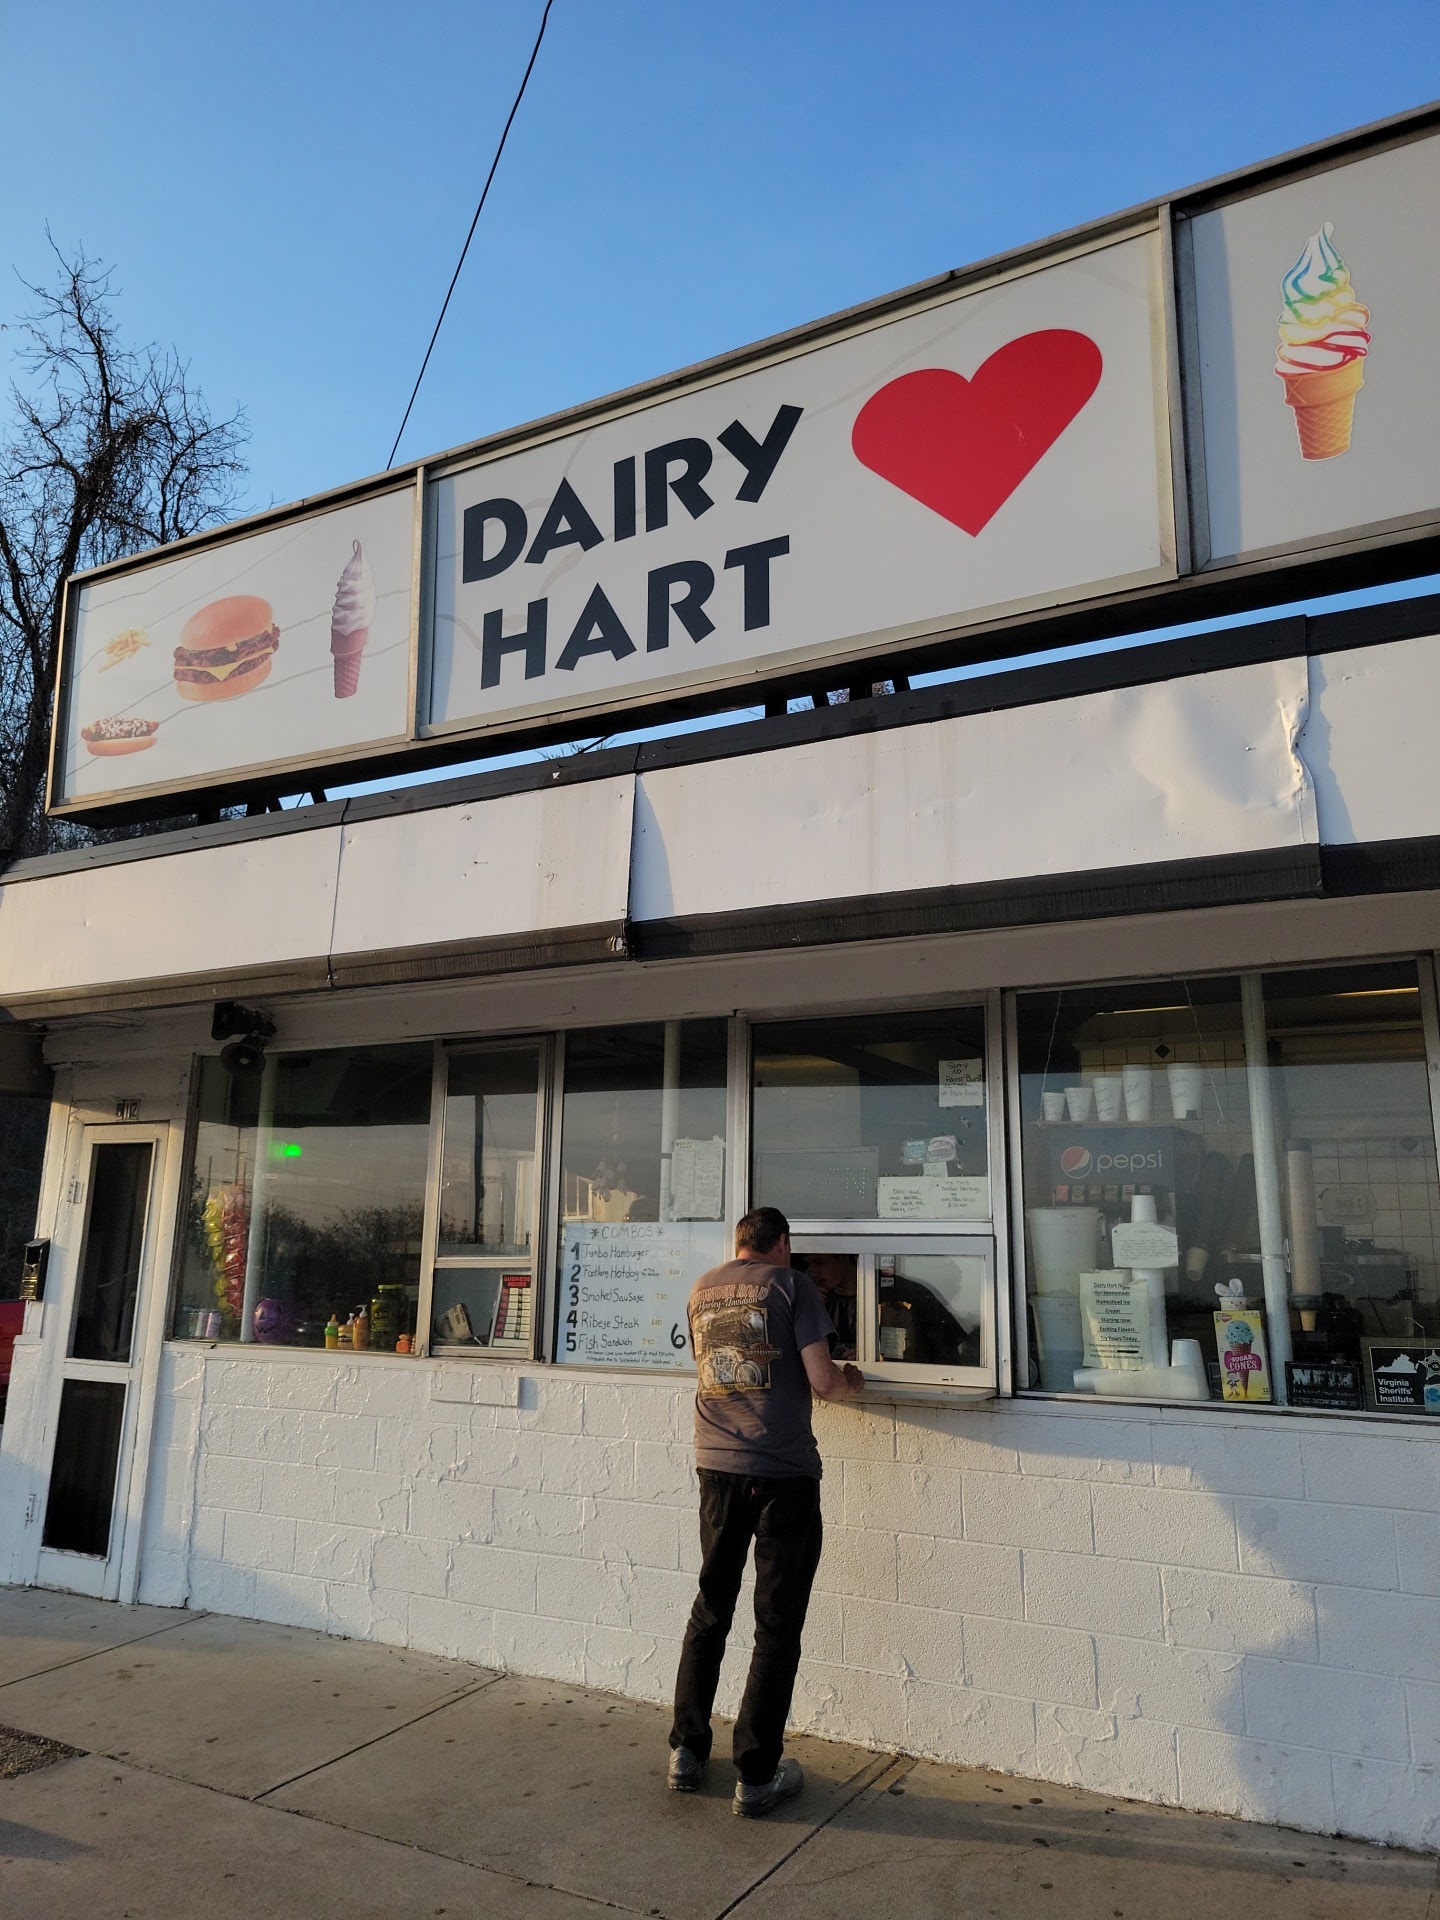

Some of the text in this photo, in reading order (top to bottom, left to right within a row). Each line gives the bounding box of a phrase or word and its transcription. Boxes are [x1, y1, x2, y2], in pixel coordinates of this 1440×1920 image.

[463, 404, 804, 584] DAIRY
[481, 535, 790, 690] HART
[1097, 1150, 1162, 1173] pepsi
[602, 1225, 653, 1239] COMBOS
[571, 1242, 580, 1260] 1
[581, 1244, 608, 1258] Jumbo
[610, 1243, 650, 1260] Hamburger
[570, 1264, 581, 1282] 2
[610, 1264, 639, 1281] Hotdog
[569, 1284, 579, 1306] 3
[581, 1287, 612, 1302] Smoked
[612, 1288, 644, 1302] Sausage
[736, 1284, 769, 1301] ROAD
[566, 1310, 578, 1328] 4
[581, 1311, 611, 1329] Ribeye
[612, 1315, 639, 1329] Steak
[566, 1332, 577, 1352] 5
[578, 1333, 598, 1350] Fish
[670, 1323, 686, 1349] 6
[1229, 1360, 1257, 1370] CONES
[1378, 1379, 1409, 1388] Virginia
[1379, 1386, 1413, 1395] Sheriffs'
[1380, 1395, 1414, 1403] Institute
